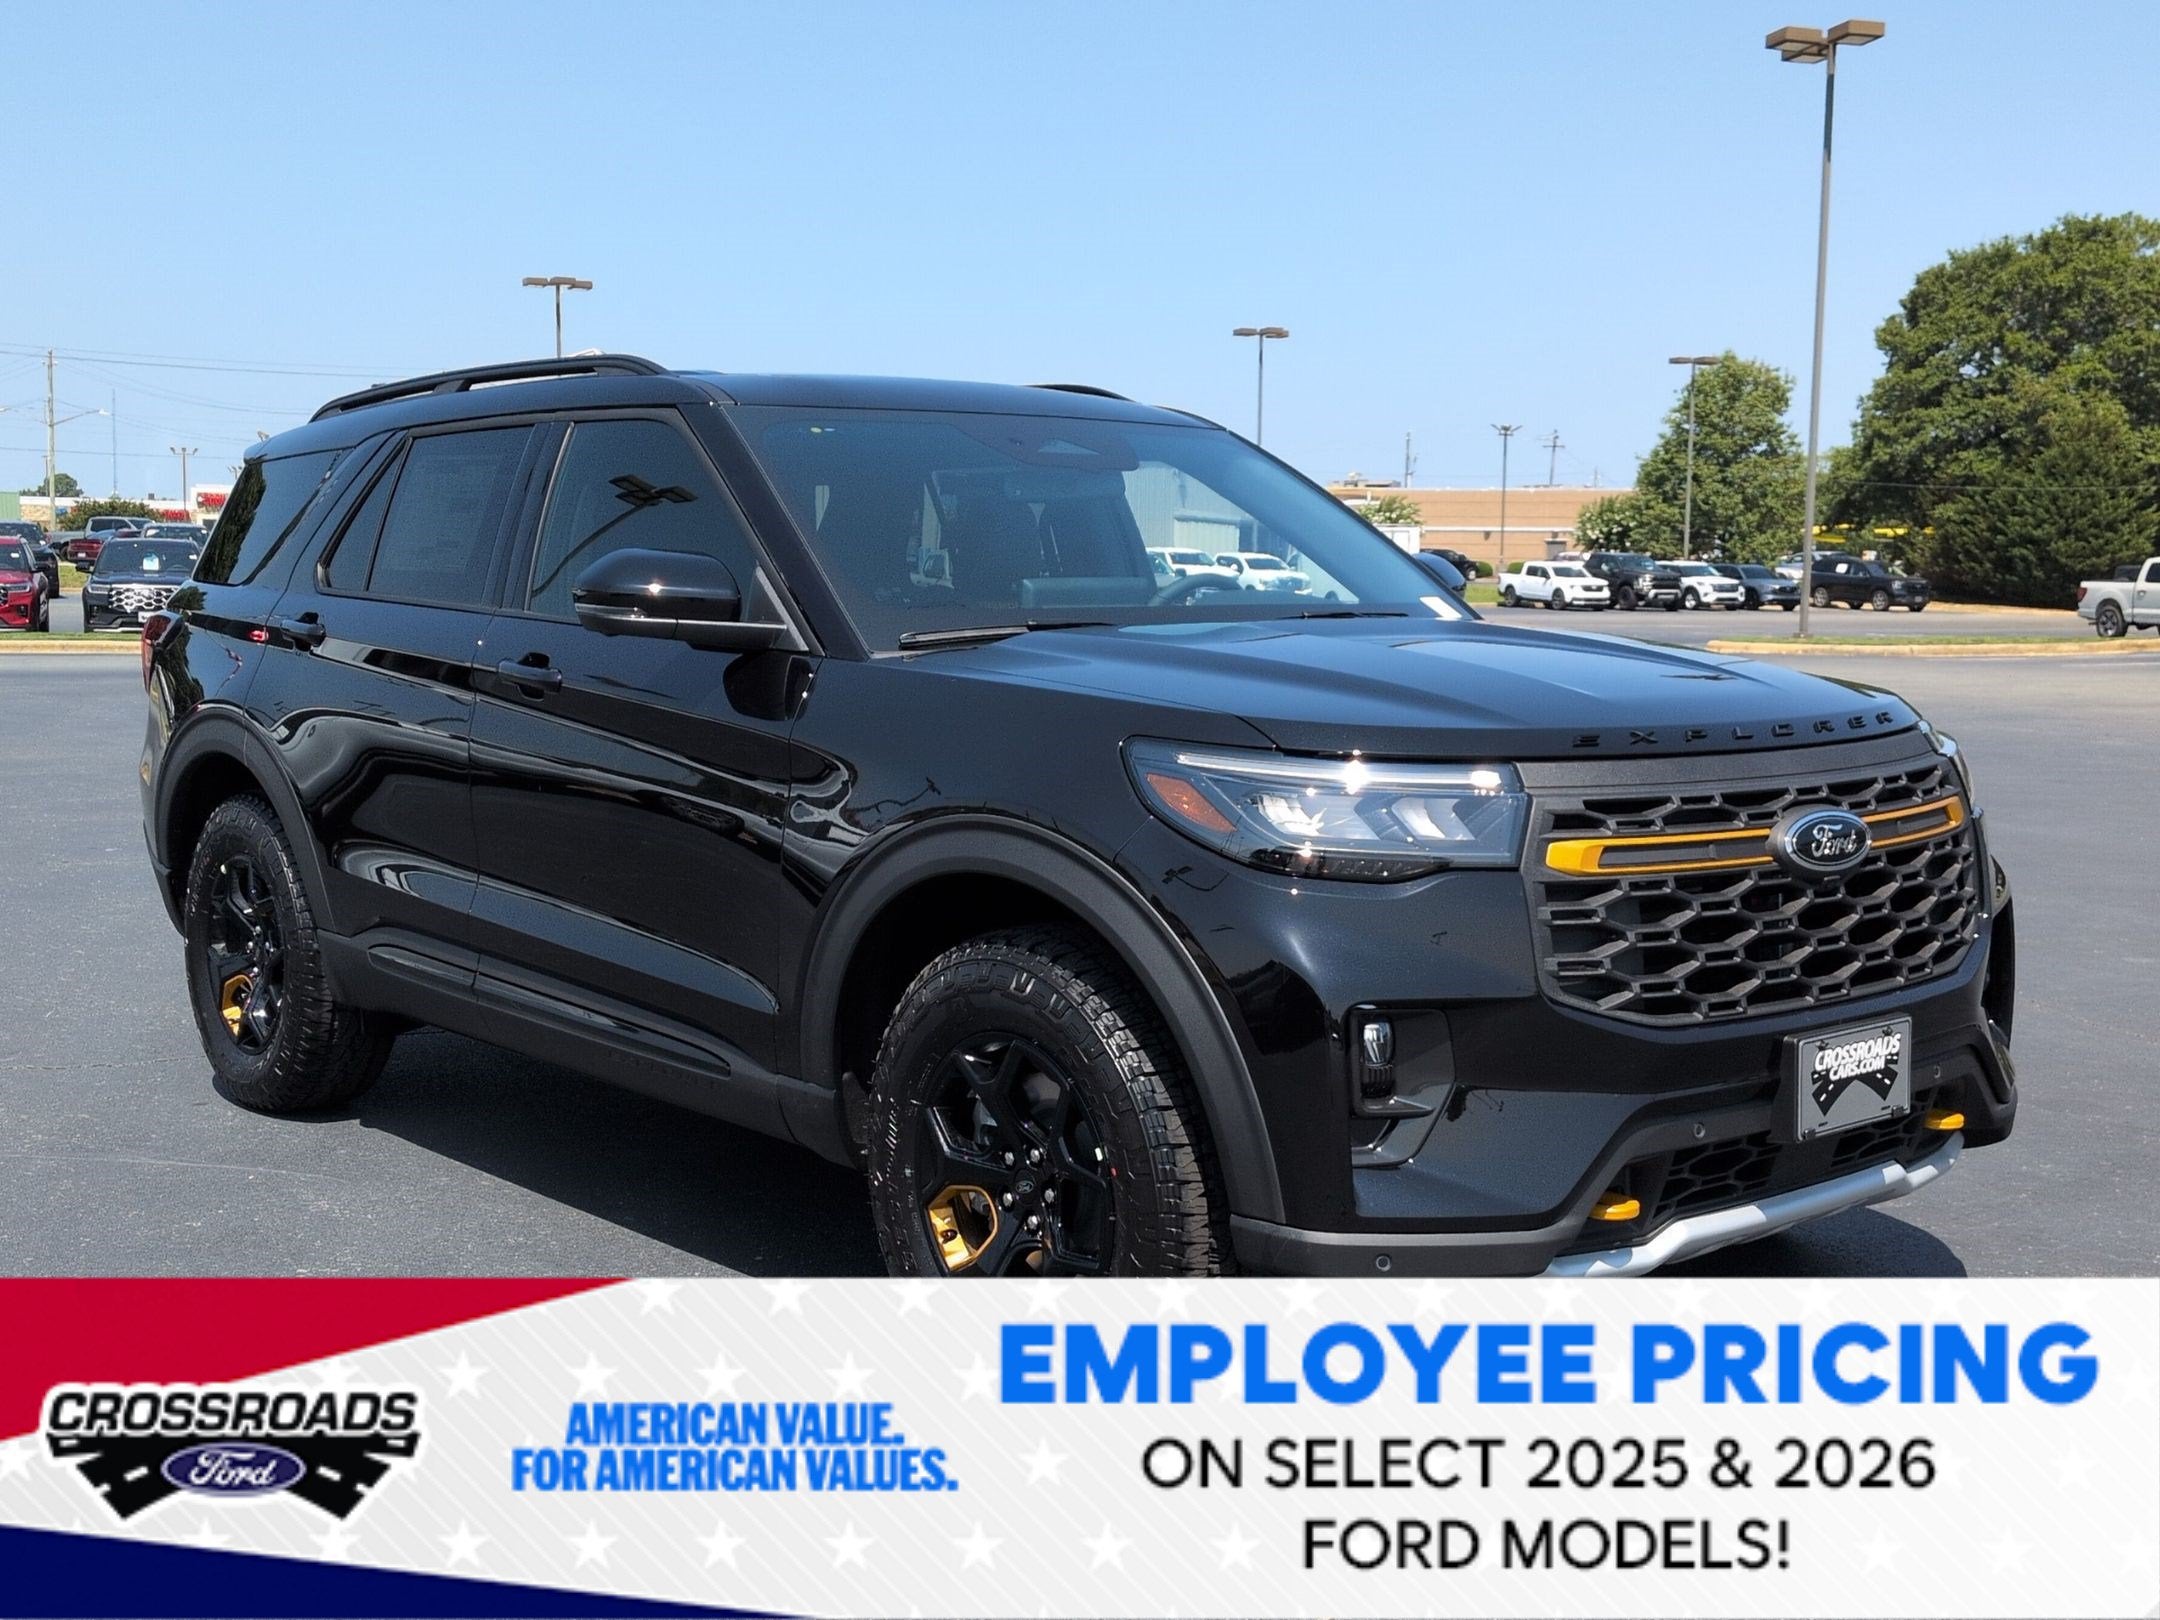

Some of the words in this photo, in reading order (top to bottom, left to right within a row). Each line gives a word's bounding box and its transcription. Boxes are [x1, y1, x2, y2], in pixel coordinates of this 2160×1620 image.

[1572, 711, 1895, 748] EXPLORER
[1811, 824, 1857, 858] Ford
[1815, 1033, 1901, 1071] CROSSROADS
[1829, 1055, 1885, 1081] CARS.COM
